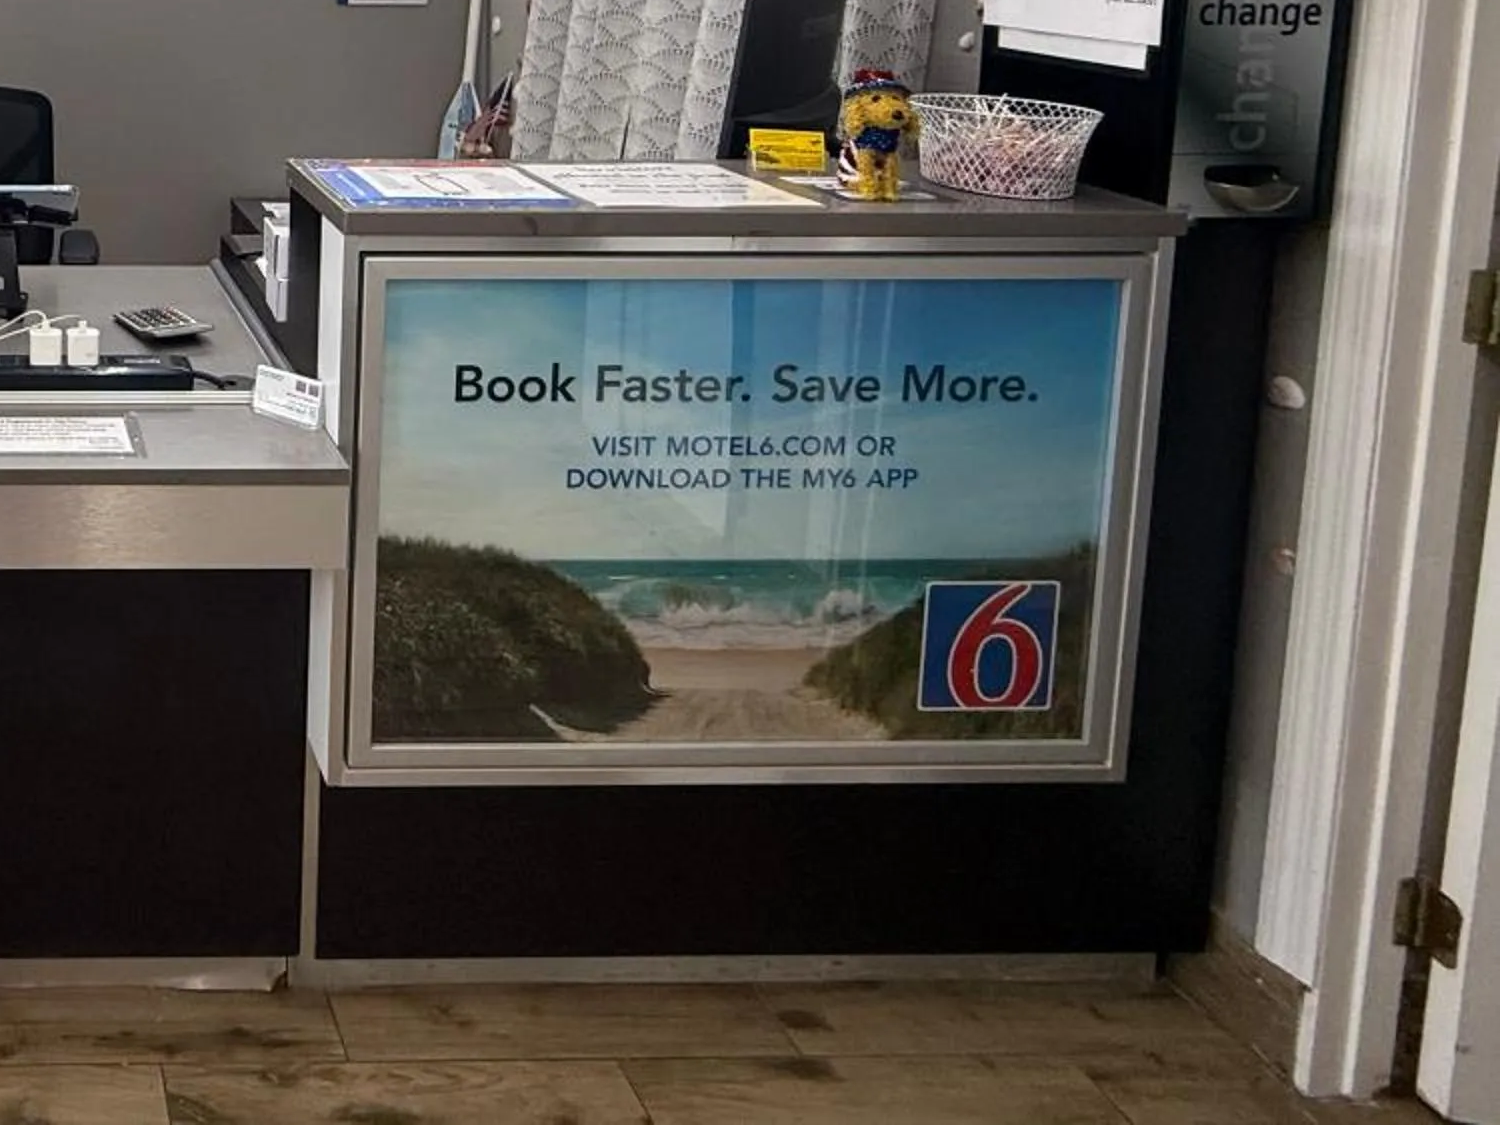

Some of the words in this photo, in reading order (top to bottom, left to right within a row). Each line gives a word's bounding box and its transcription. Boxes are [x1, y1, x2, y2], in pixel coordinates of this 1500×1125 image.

[453, 362, 577, 404] Book
[595, 364, 751, 404] Faster.
[771, 364, 882, 404] Save
[901, 364, 1039, 404] More.
[592, 435, 657, 458] VISIT
[666, 435, 846, 458] MOTEL6.COM
[857, 435, 896, 458] OR
[565, 468, 732, 490] DOWNLOAD
[741, 468, 792, 490] THE
[802, 468, 856, 490] MY6
[867, 468, 919, 490] APP
[947, 582, 1042, 710] 6
